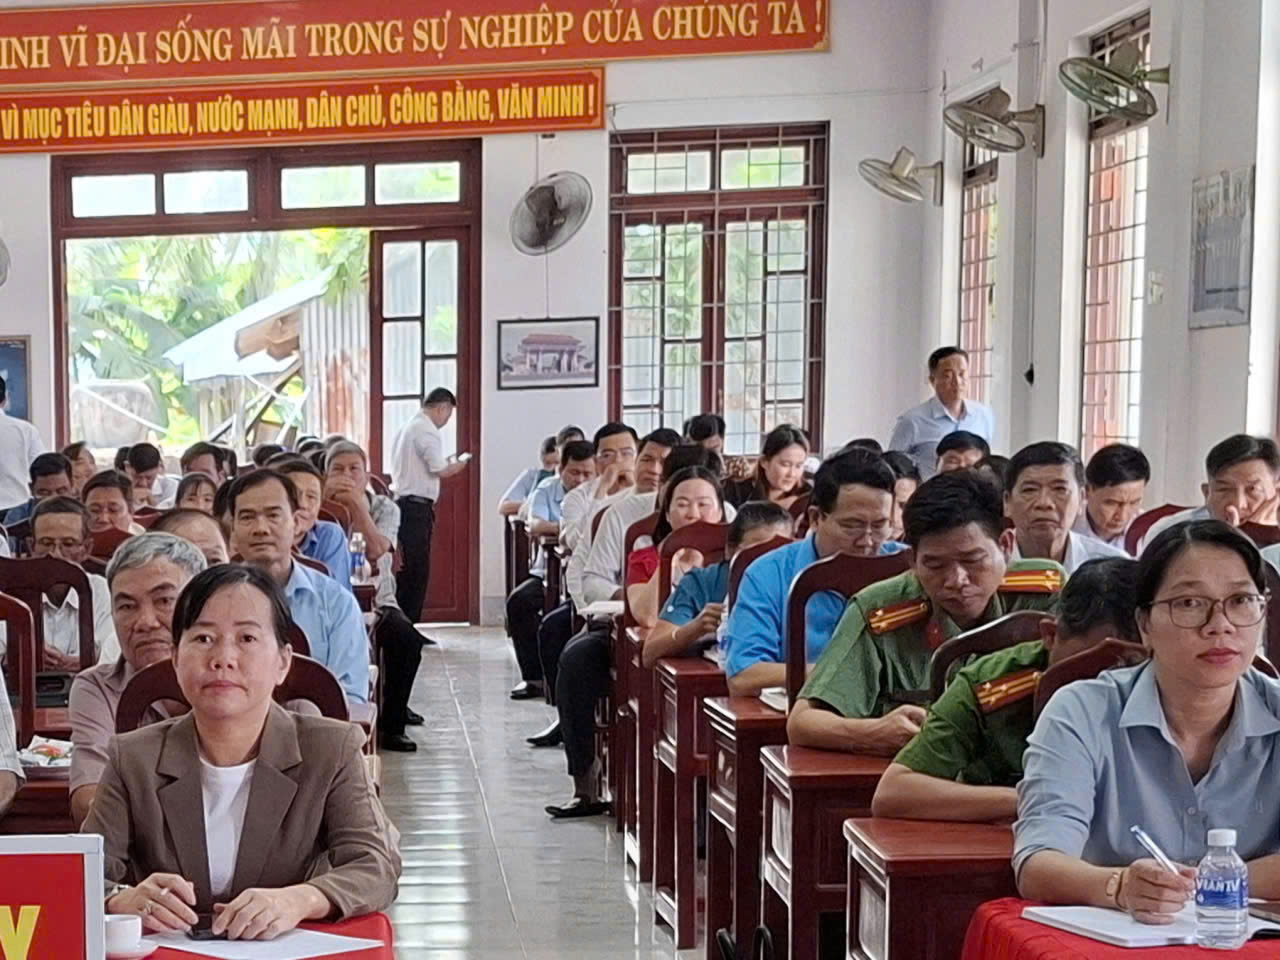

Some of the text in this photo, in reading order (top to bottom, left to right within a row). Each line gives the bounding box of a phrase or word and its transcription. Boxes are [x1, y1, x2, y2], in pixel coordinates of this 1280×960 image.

[58, 25, 88, 67] VĨ
[95, 31, 147, 73] ĐẠI
[155, 13, 233, 64] SỐNG
[240, 17, 297, 60] MÃI
[305, 20, 404, 57] TRONG
[413, 9, 451, 59] SỰ
[459, 3, 574, 55] NGHIỆP
[768, 1, 806, 35] TA
[0, 103, 19, 140] VÌ
[23, 106, 63, 145] MỤC
[65, 100, 105, 138] TIÊU
[108, 98, 144, 136] DÂN
[147, 96, 193, 136] GIÀU,
[197, 93, 244, 133] NƯỚC
[247, 97, 303, 137] MẠNH,
[306, 89, 342, 128] DÂN
[345, 84, 386, 127] CHỦ,
[389, 86, 438, 126] CÔNG
[441, 80, 494, 124] BẰNG,
[497, 83, 533, 120] VĂN
[536, 84, 584, 118] MINH
